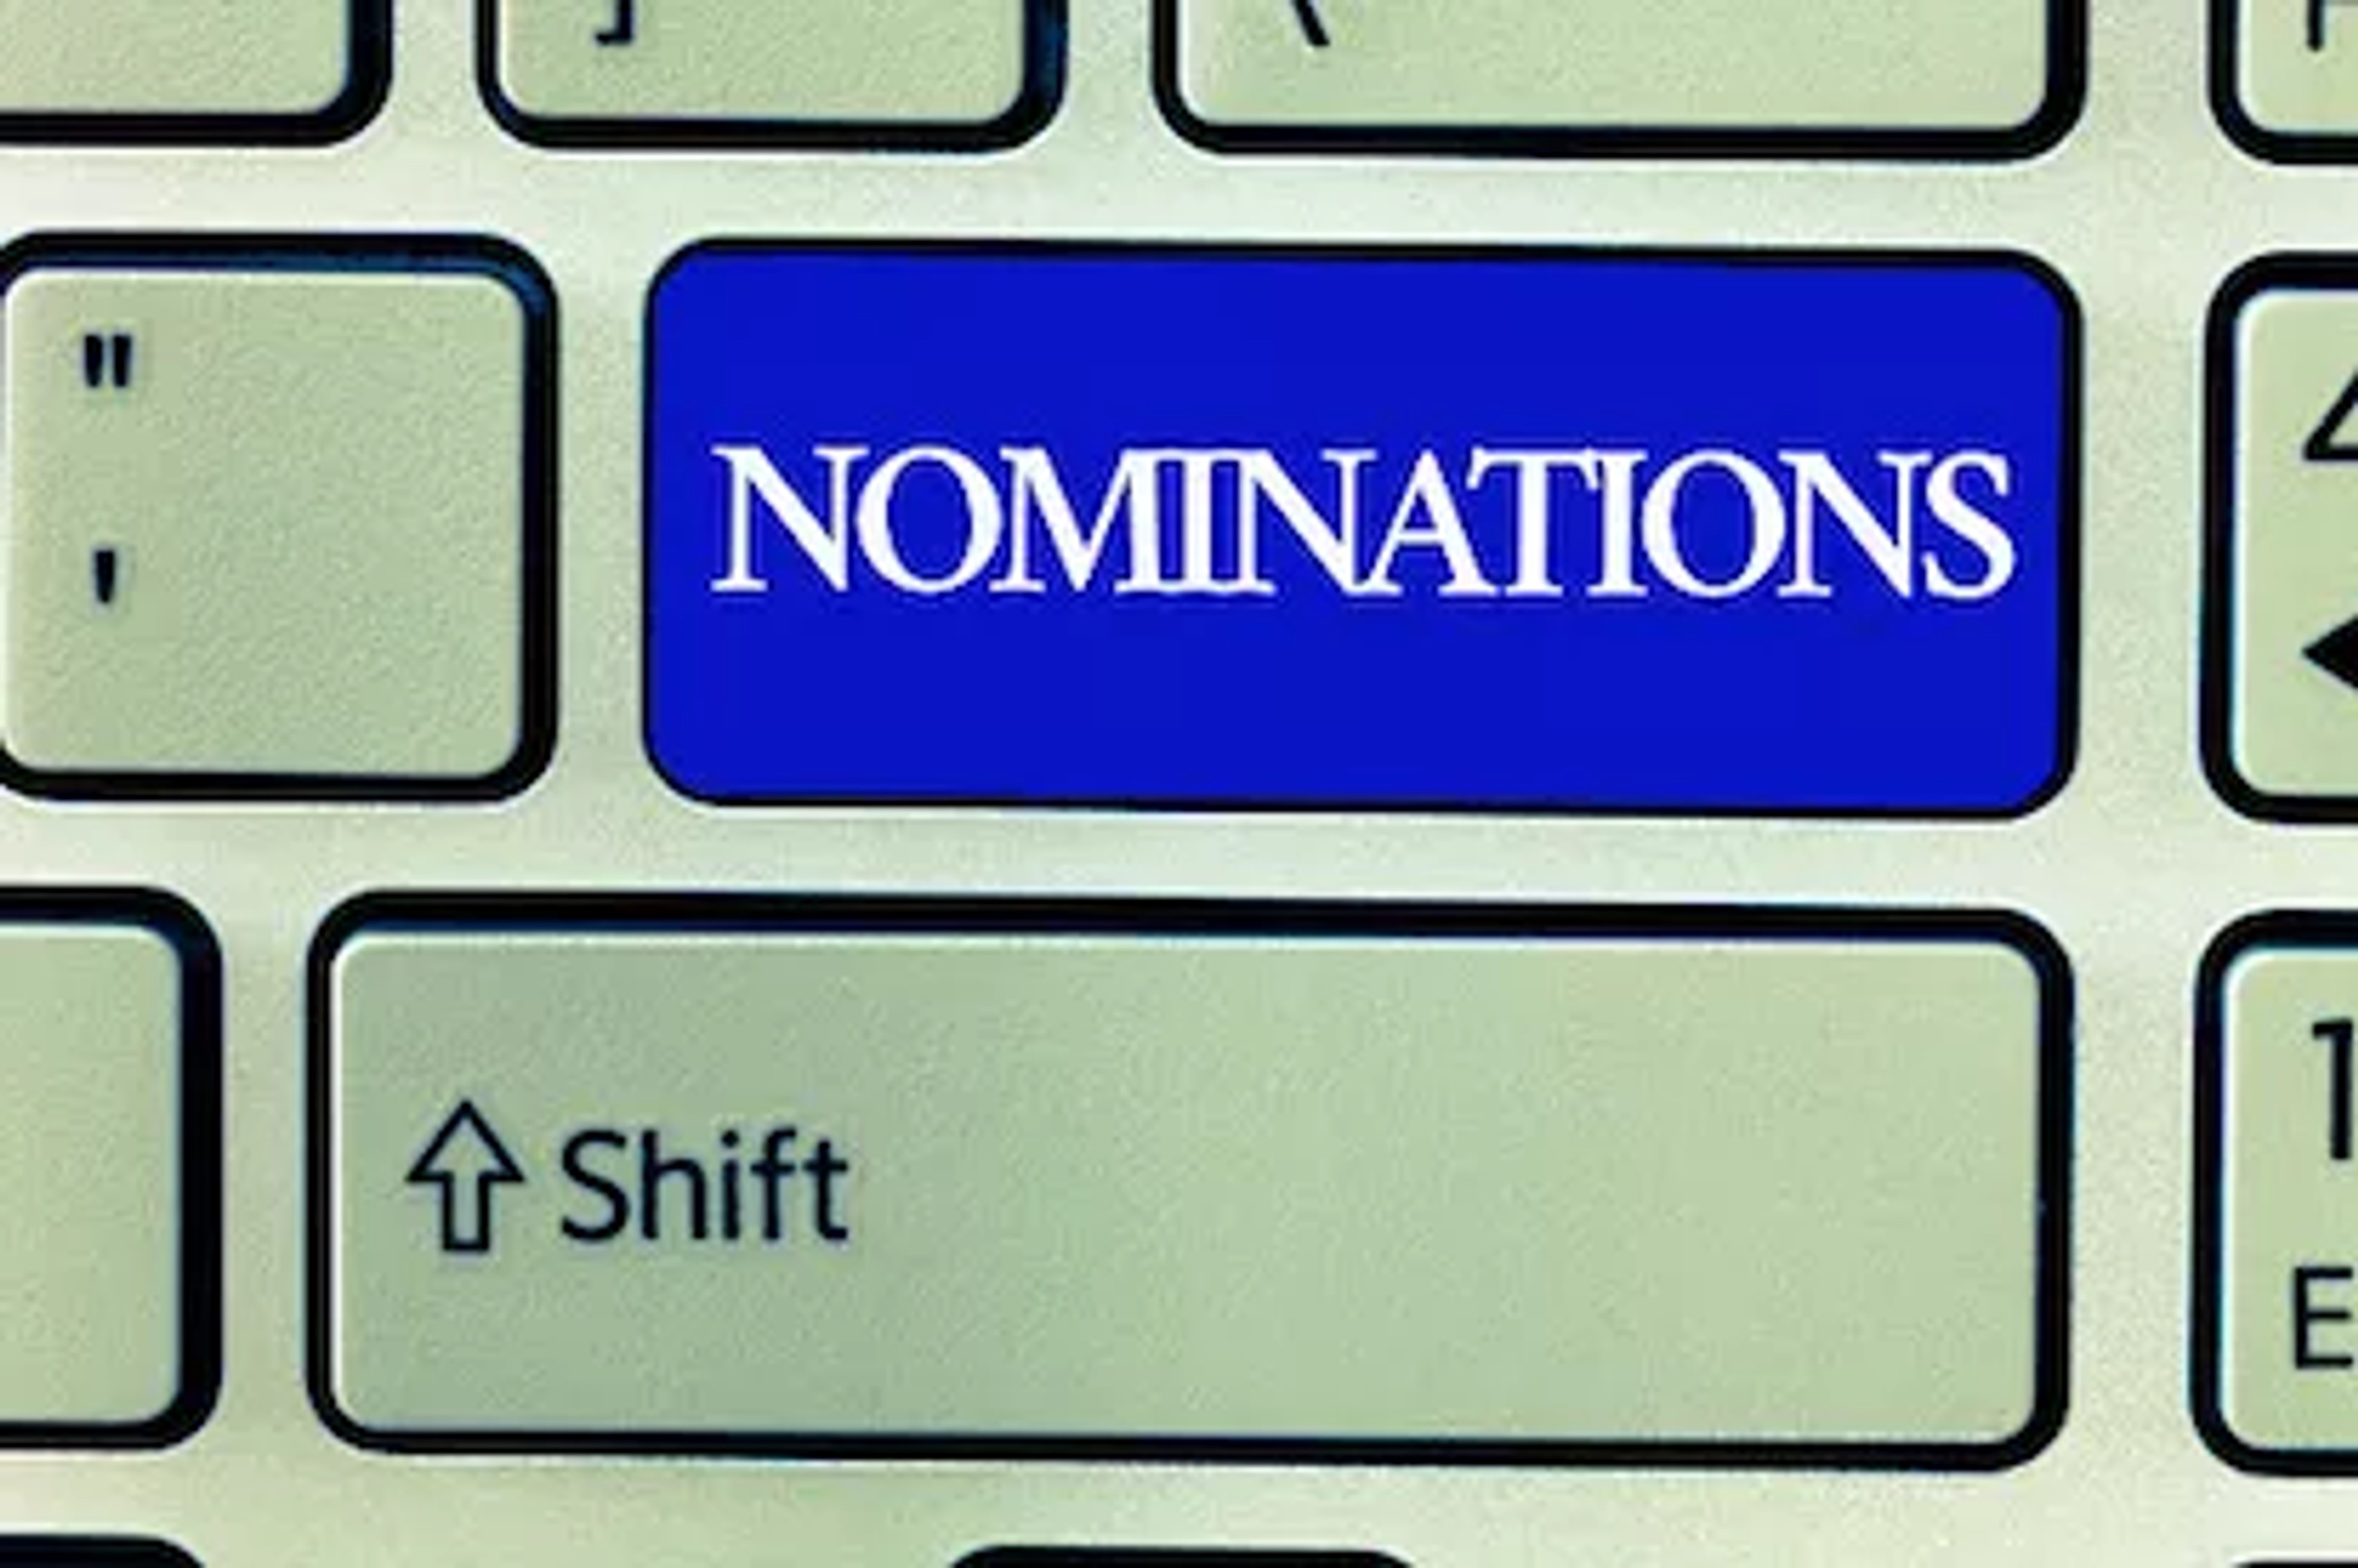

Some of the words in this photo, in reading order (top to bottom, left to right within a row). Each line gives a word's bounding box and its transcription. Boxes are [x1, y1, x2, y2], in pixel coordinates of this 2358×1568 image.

[710, 443, 2017, 600] NOMINATIONS
[2310, 1017, 2355, 1162] 1
[558, 1125, 851, 1245] Shift
